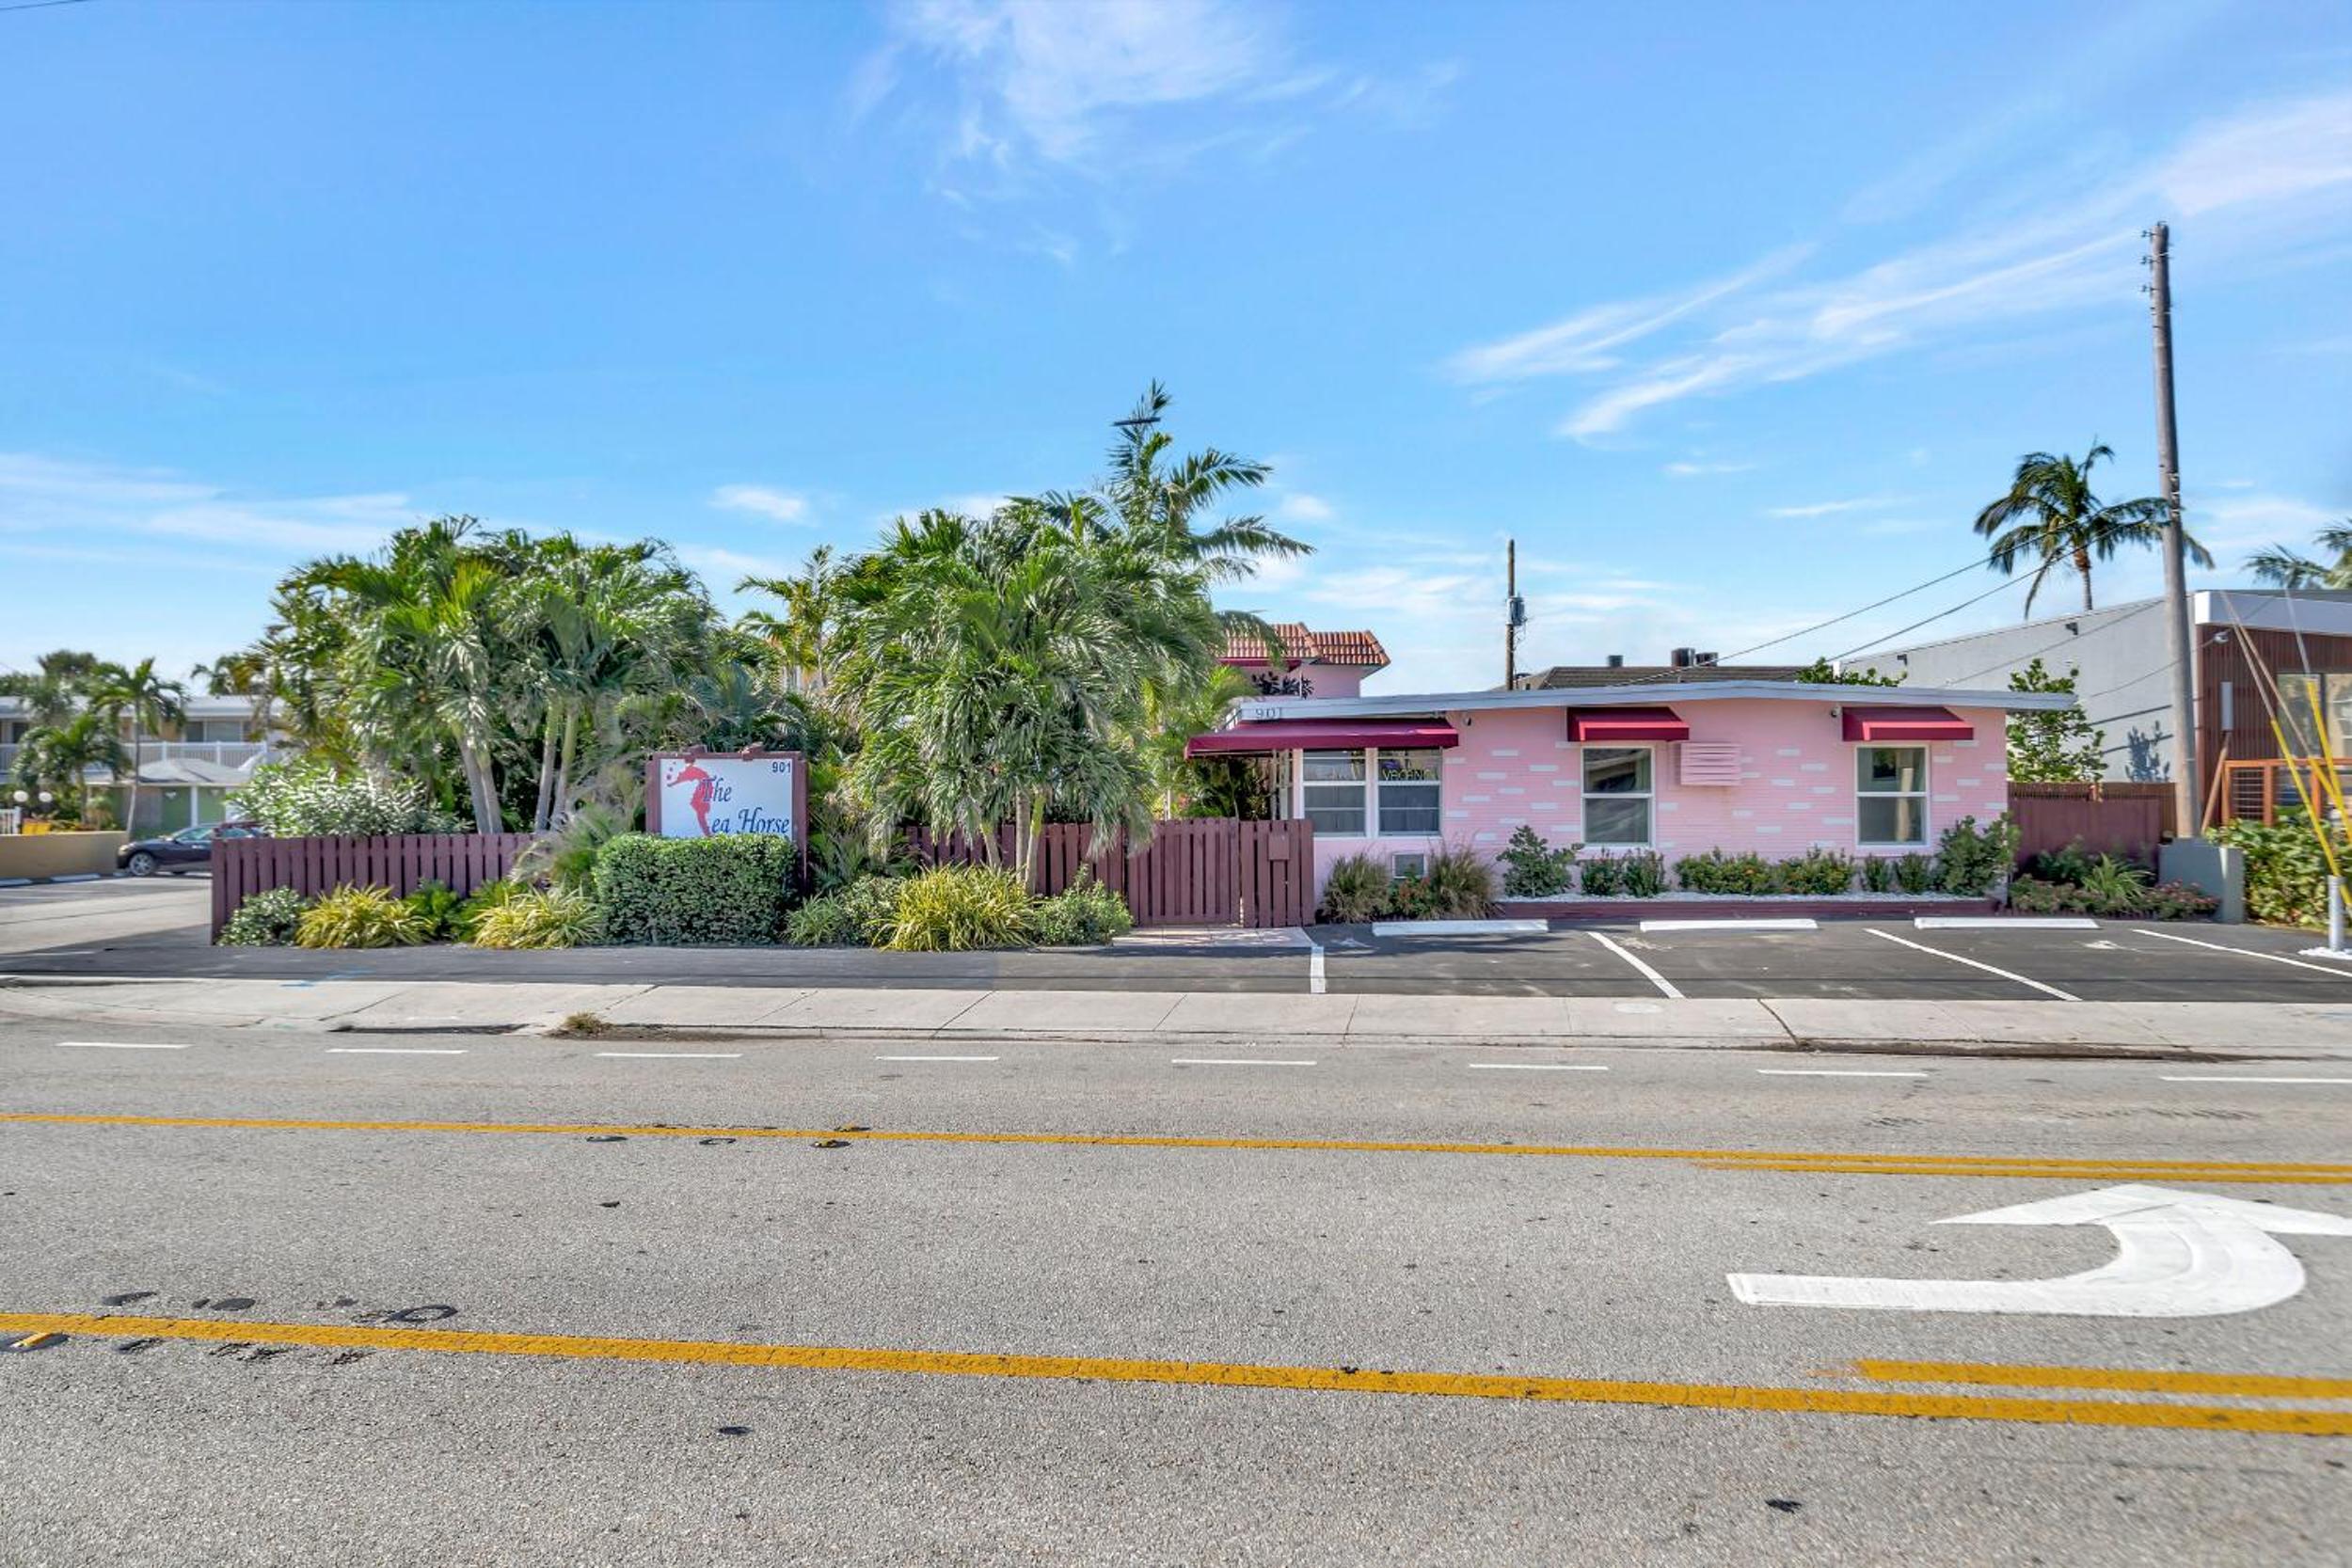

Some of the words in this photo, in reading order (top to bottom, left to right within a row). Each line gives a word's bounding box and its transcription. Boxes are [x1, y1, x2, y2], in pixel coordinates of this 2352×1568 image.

[1255, 707, 1282, 719] 901
[771, 761, 791, 773] 901
[699, 774, 732, 802] The
[737, 807, 790, 834] Horse
